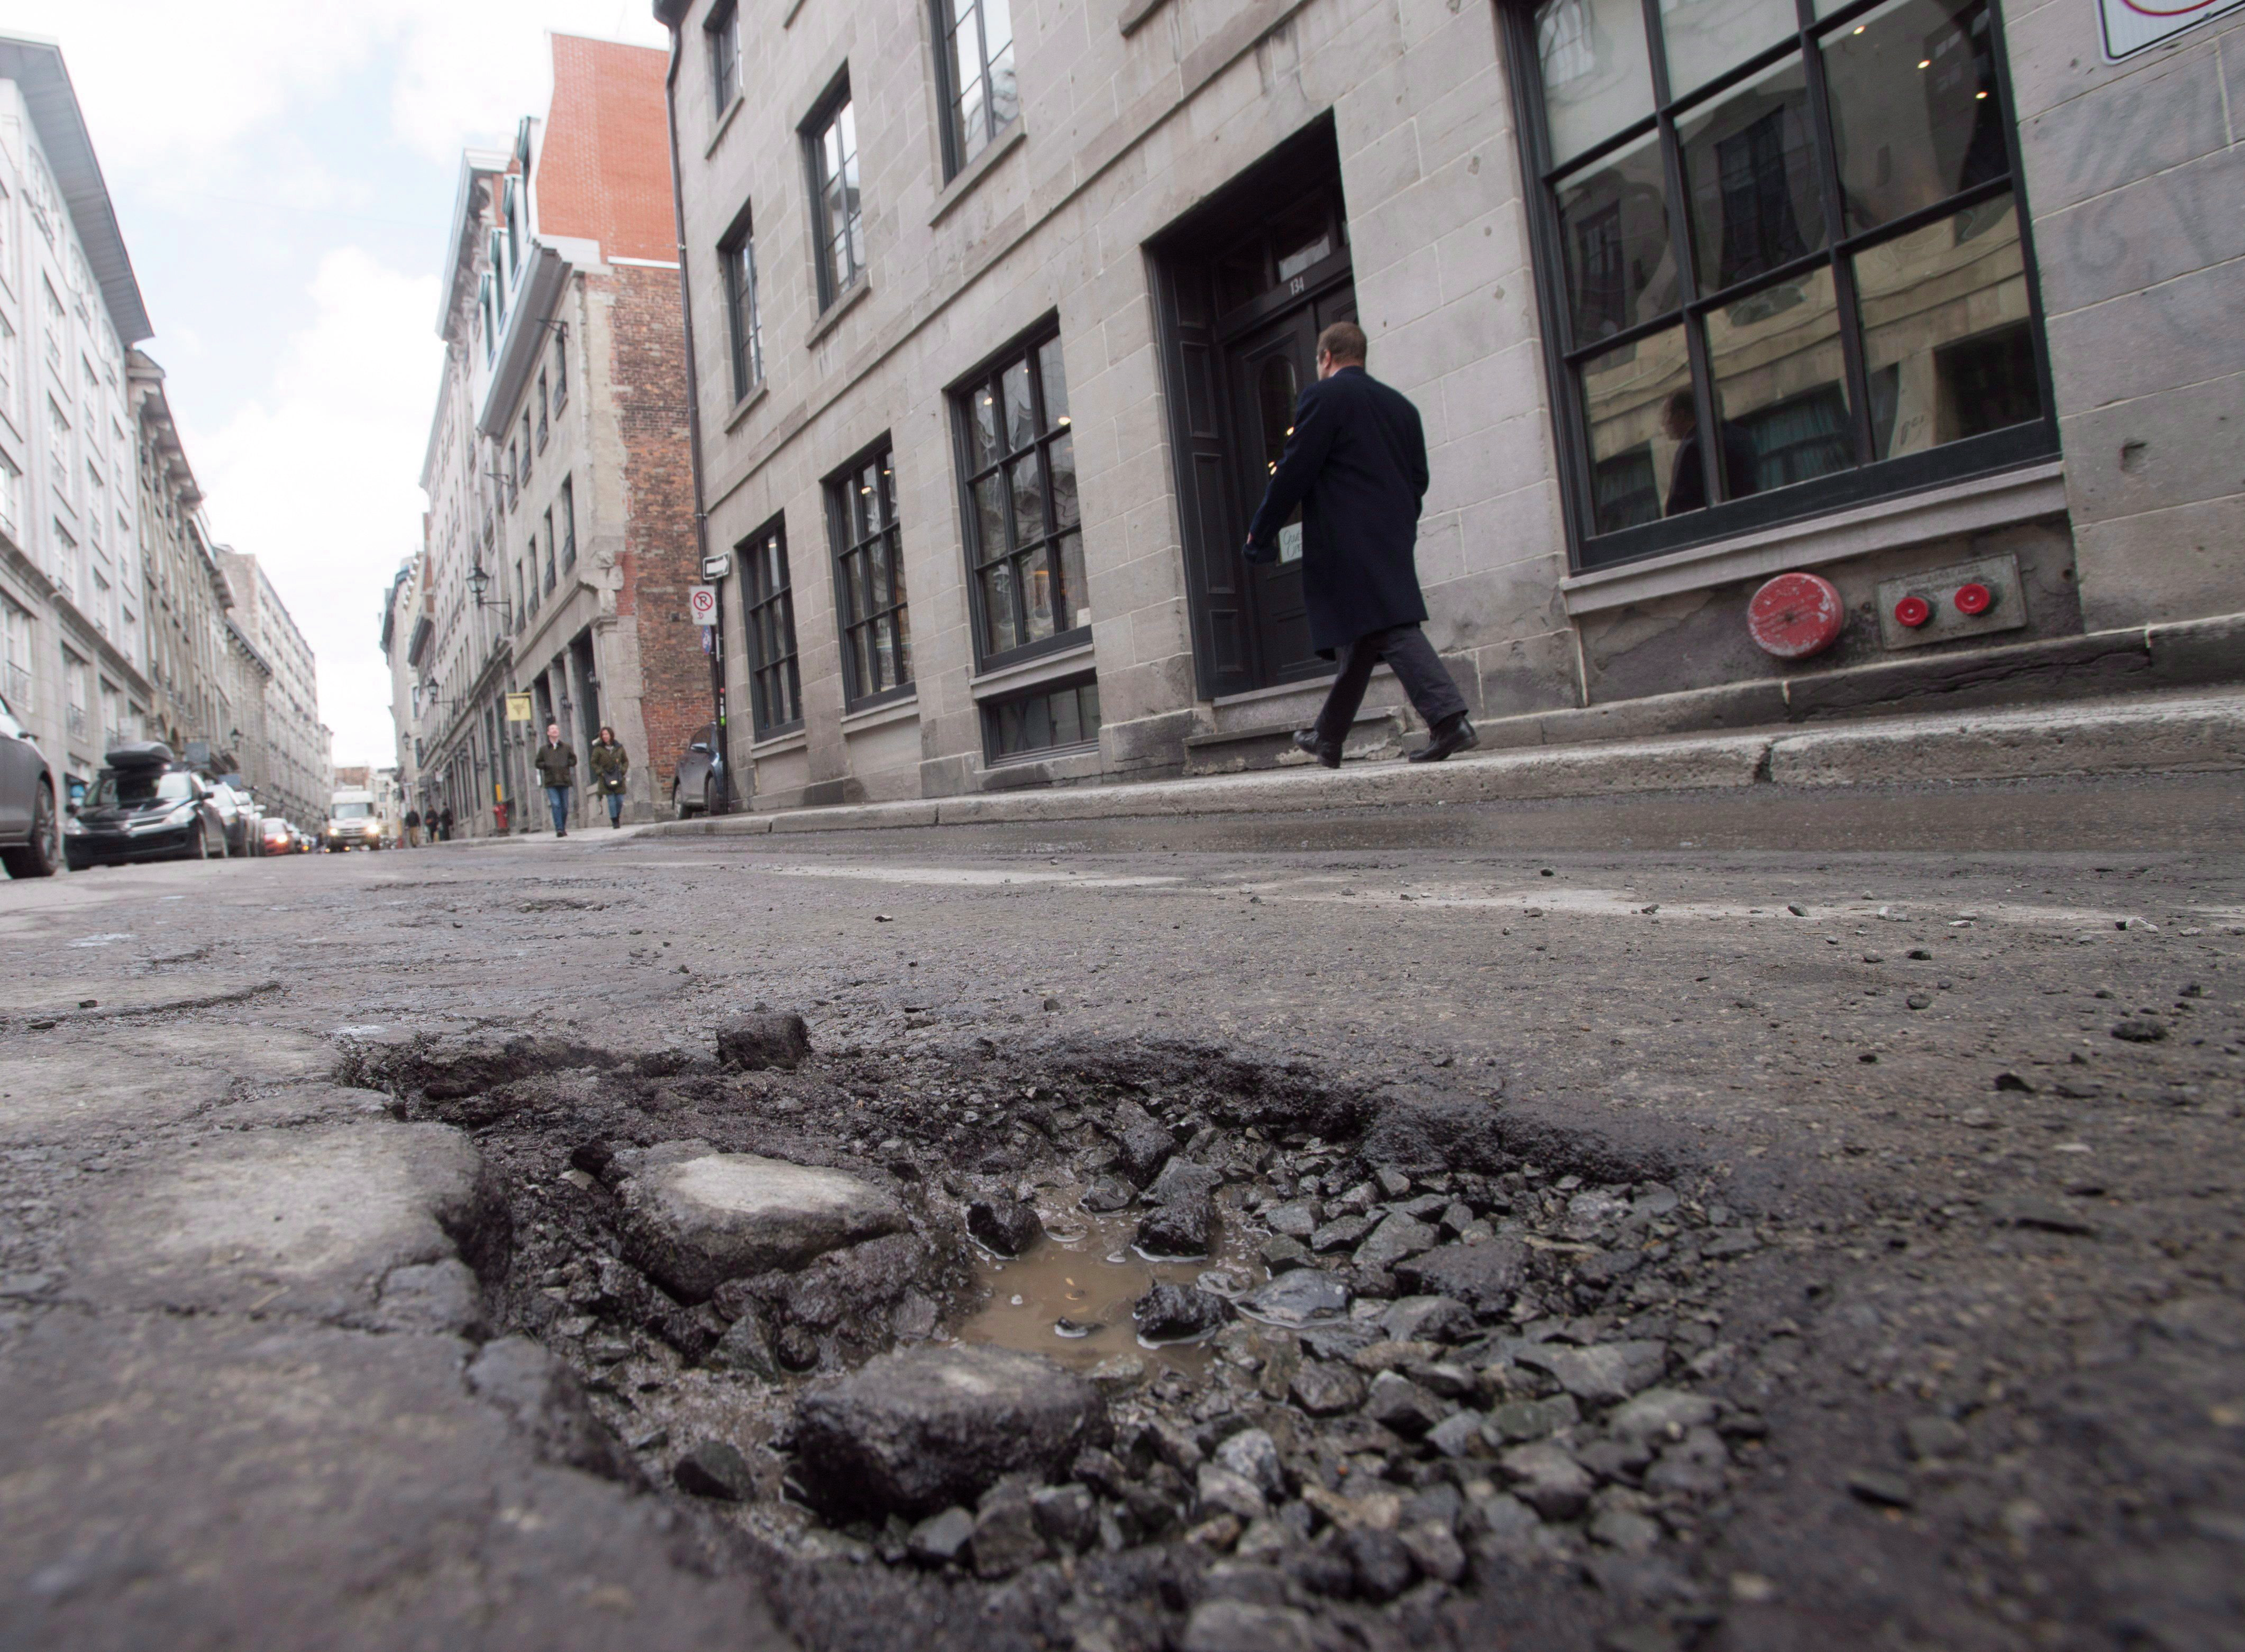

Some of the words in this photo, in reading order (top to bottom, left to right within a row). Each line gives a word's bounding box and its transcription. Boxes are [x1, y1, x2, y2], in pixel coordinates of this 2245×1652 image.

[1290, 276, 1304, 295] 134
[1287, 543, 1302, 558] OPE
[699, 595, 707, 606] P
